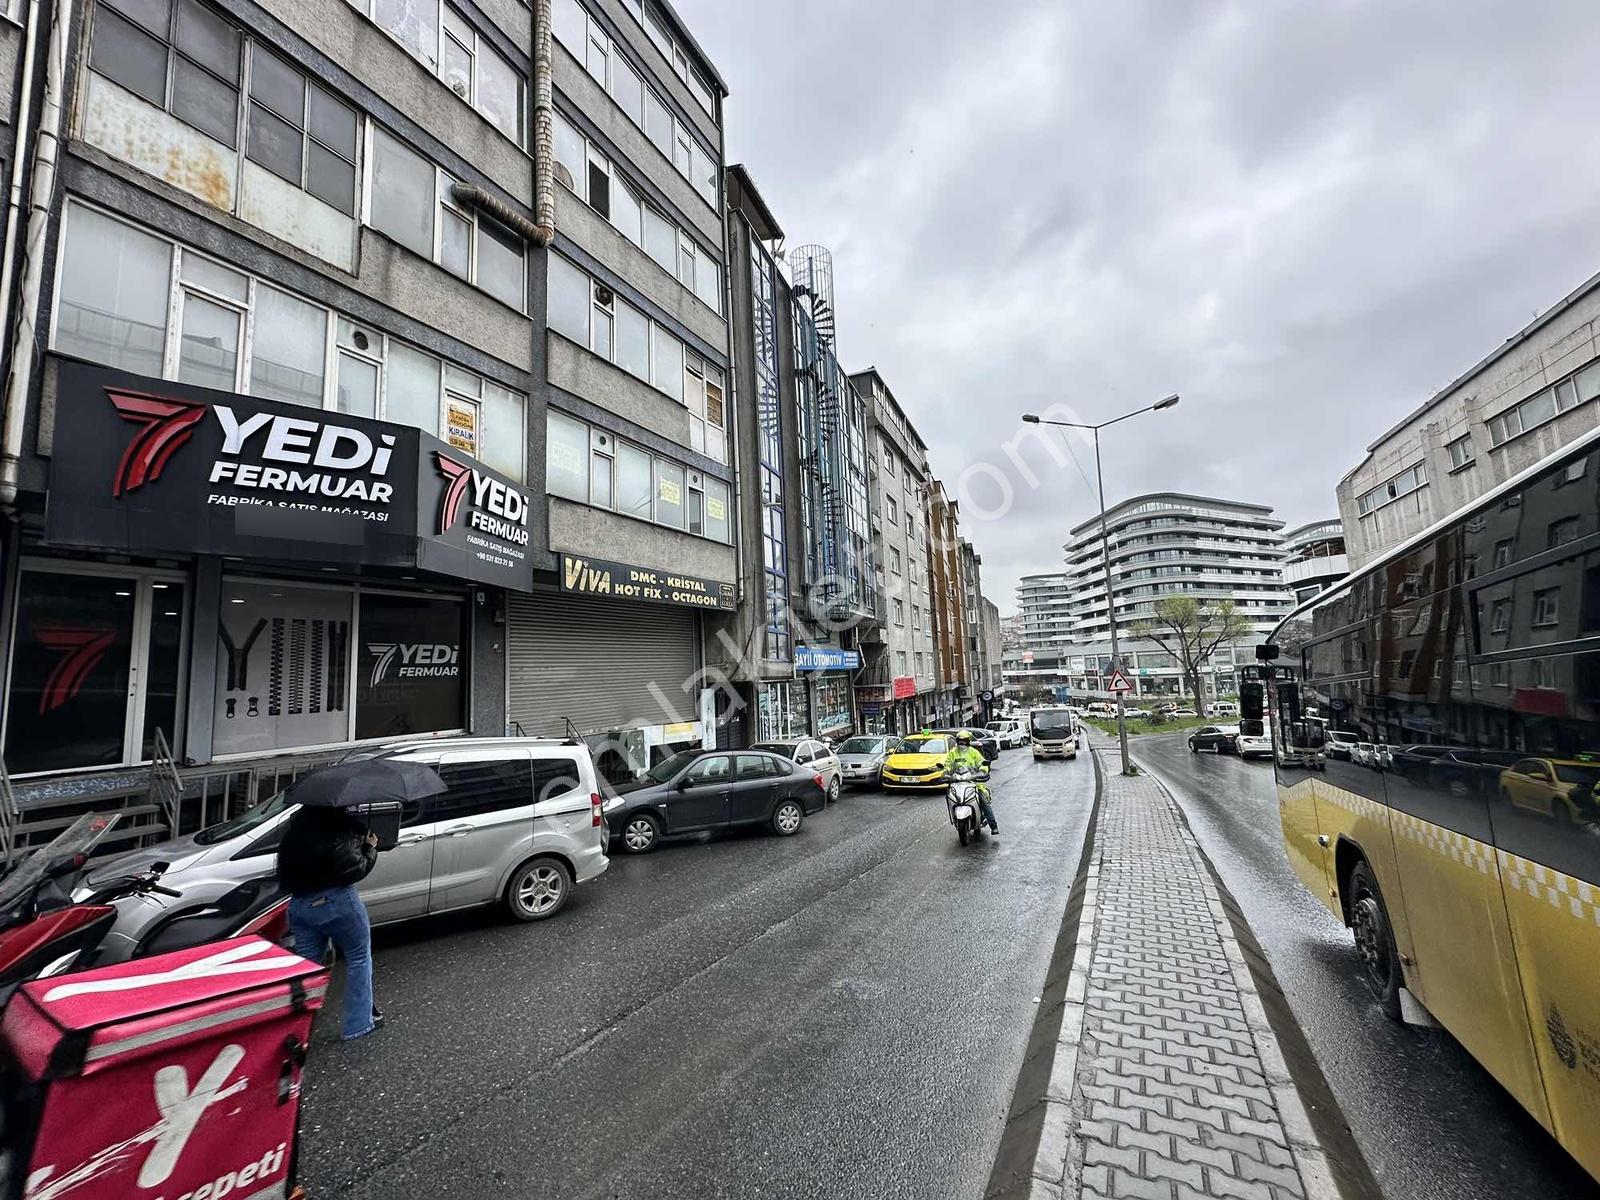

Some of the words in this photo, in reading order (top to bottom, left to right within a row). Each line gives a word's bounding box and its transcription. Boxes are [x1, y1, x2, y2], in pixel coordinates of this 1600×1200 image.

[208, 461, 394, 503] FERMUAR
[471, 510, 529, 547] FERMUAR
[630, 570, 657, 585] DMC
[667, 576, 707, 592] KRİSTAL
[614, 583, 640, 597] HOT
[672, 591, 718, 606] OCTAGON
[813, 652, 842, 666] OTOMOTİV
[398, 666, 460, 677] FERMUAR
